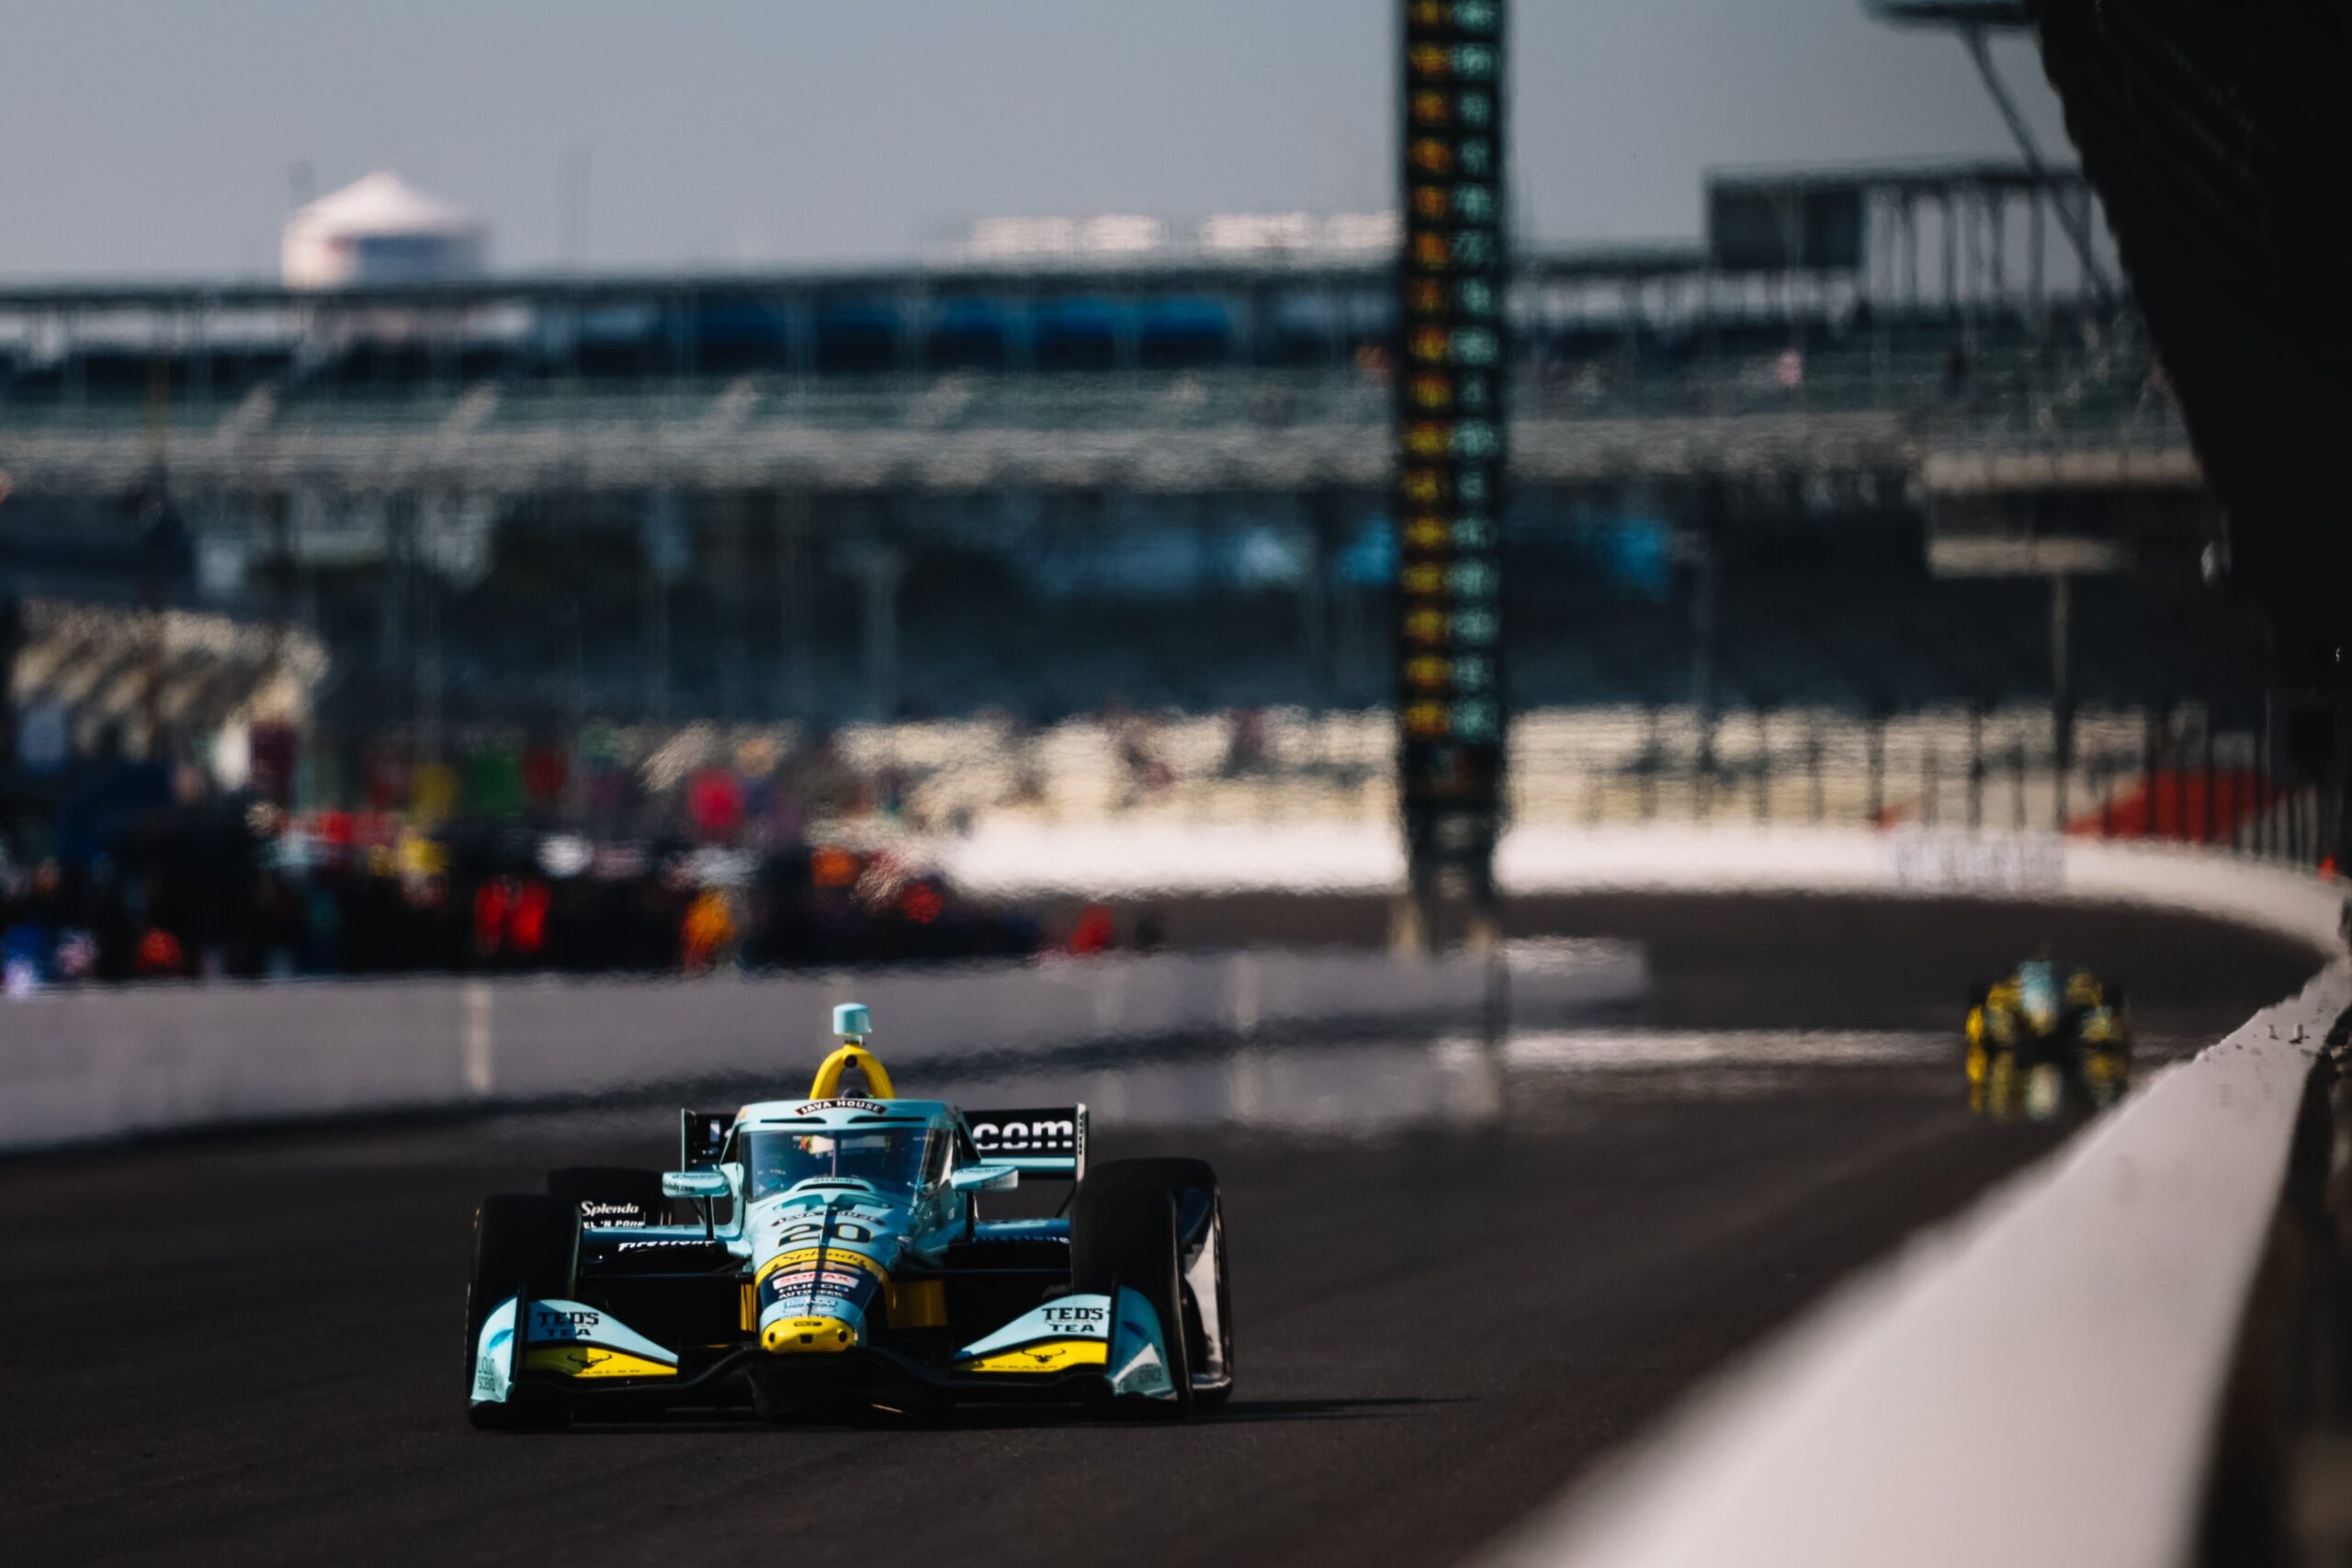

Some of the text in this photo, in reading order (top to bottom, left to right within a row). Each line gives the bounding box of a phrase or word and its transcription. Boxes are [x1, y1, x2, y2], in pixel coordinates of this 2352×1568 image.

[800, 1099, 881, 1114] JAVA HOUSE
[972, 1120, 1074, 1150] com
[581, 1200, 639, 1217] Splenda
[776, 1223, 874, 1247] 20
[782, 1250, 866, 1267] Splnda
[537, 1312, 599, 1325] TED'S
[1042, 1307, 1102, 1321] TED'S
[546, 1327, 592, 1337] TEA
[1049, 1324, 1095, 1332] TEA
